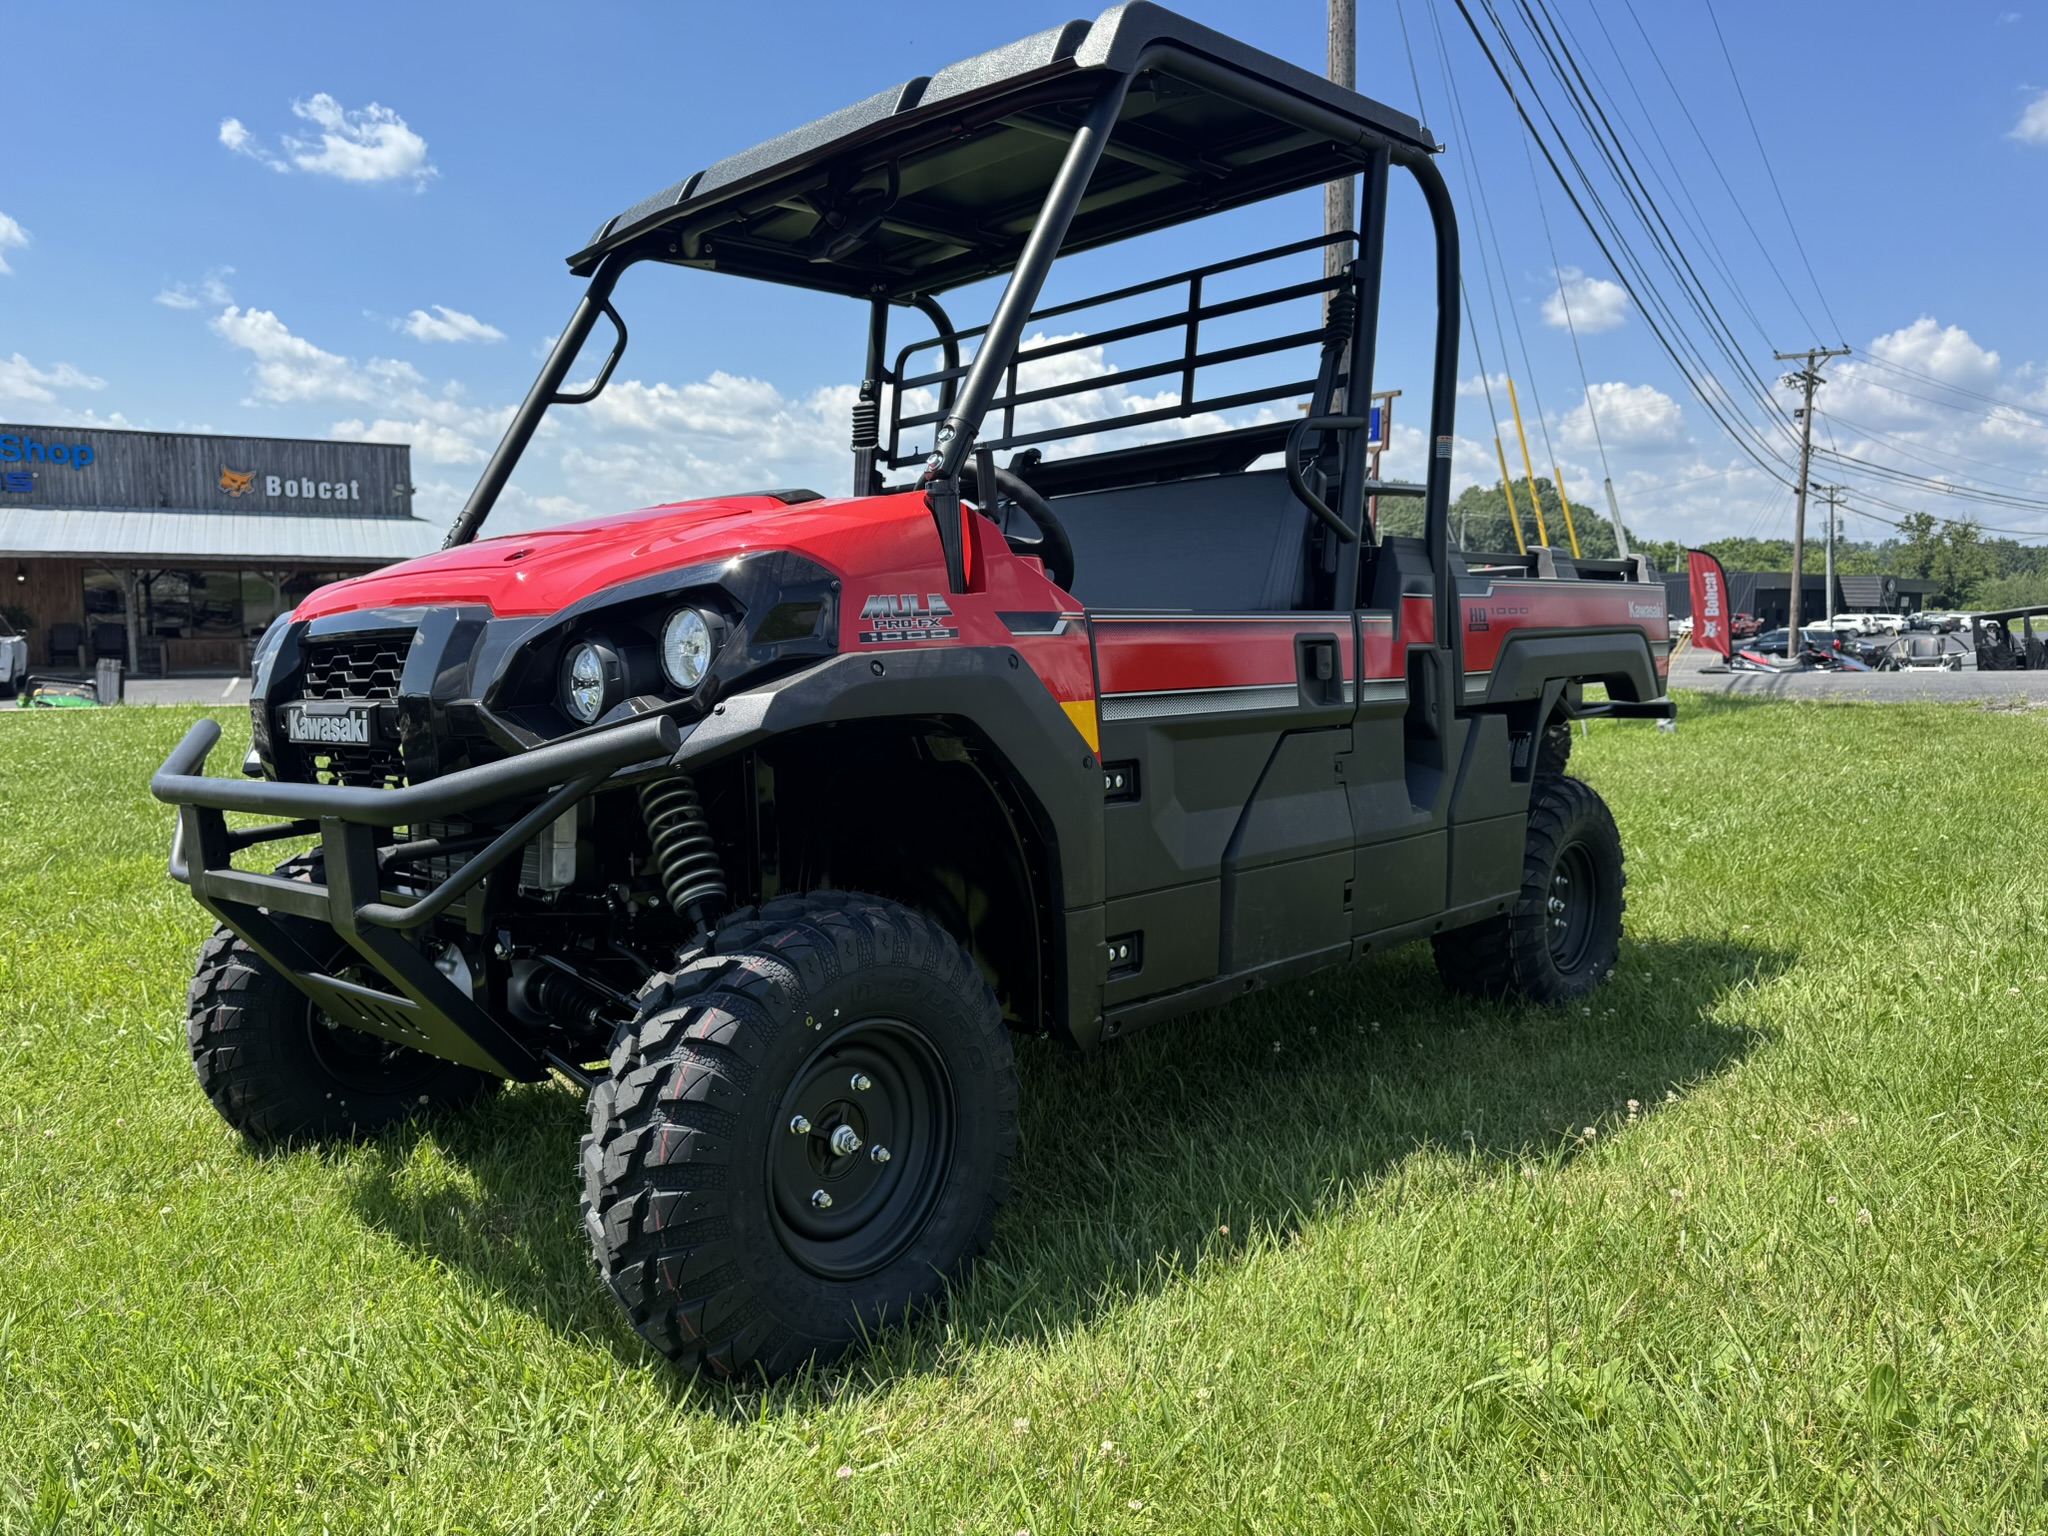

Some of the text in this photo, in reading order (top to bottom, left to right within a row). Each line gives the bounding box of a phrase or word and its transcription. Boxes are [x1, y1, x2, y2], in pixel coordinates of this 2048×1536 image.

[0, 434, 95, 471] Shop
[265, 475, 360, 500] Bobcat
[859, 593, 954, 619] MULE
[1703, 571, 1719, 616] Bobcat
[1469, 607, 1529, 622] HD 1000
[1628, 601, 1664, 618] Kawasaki
[869, 629, 950, 641] 1000
[289, 709, 368, 742] Kawasaki
